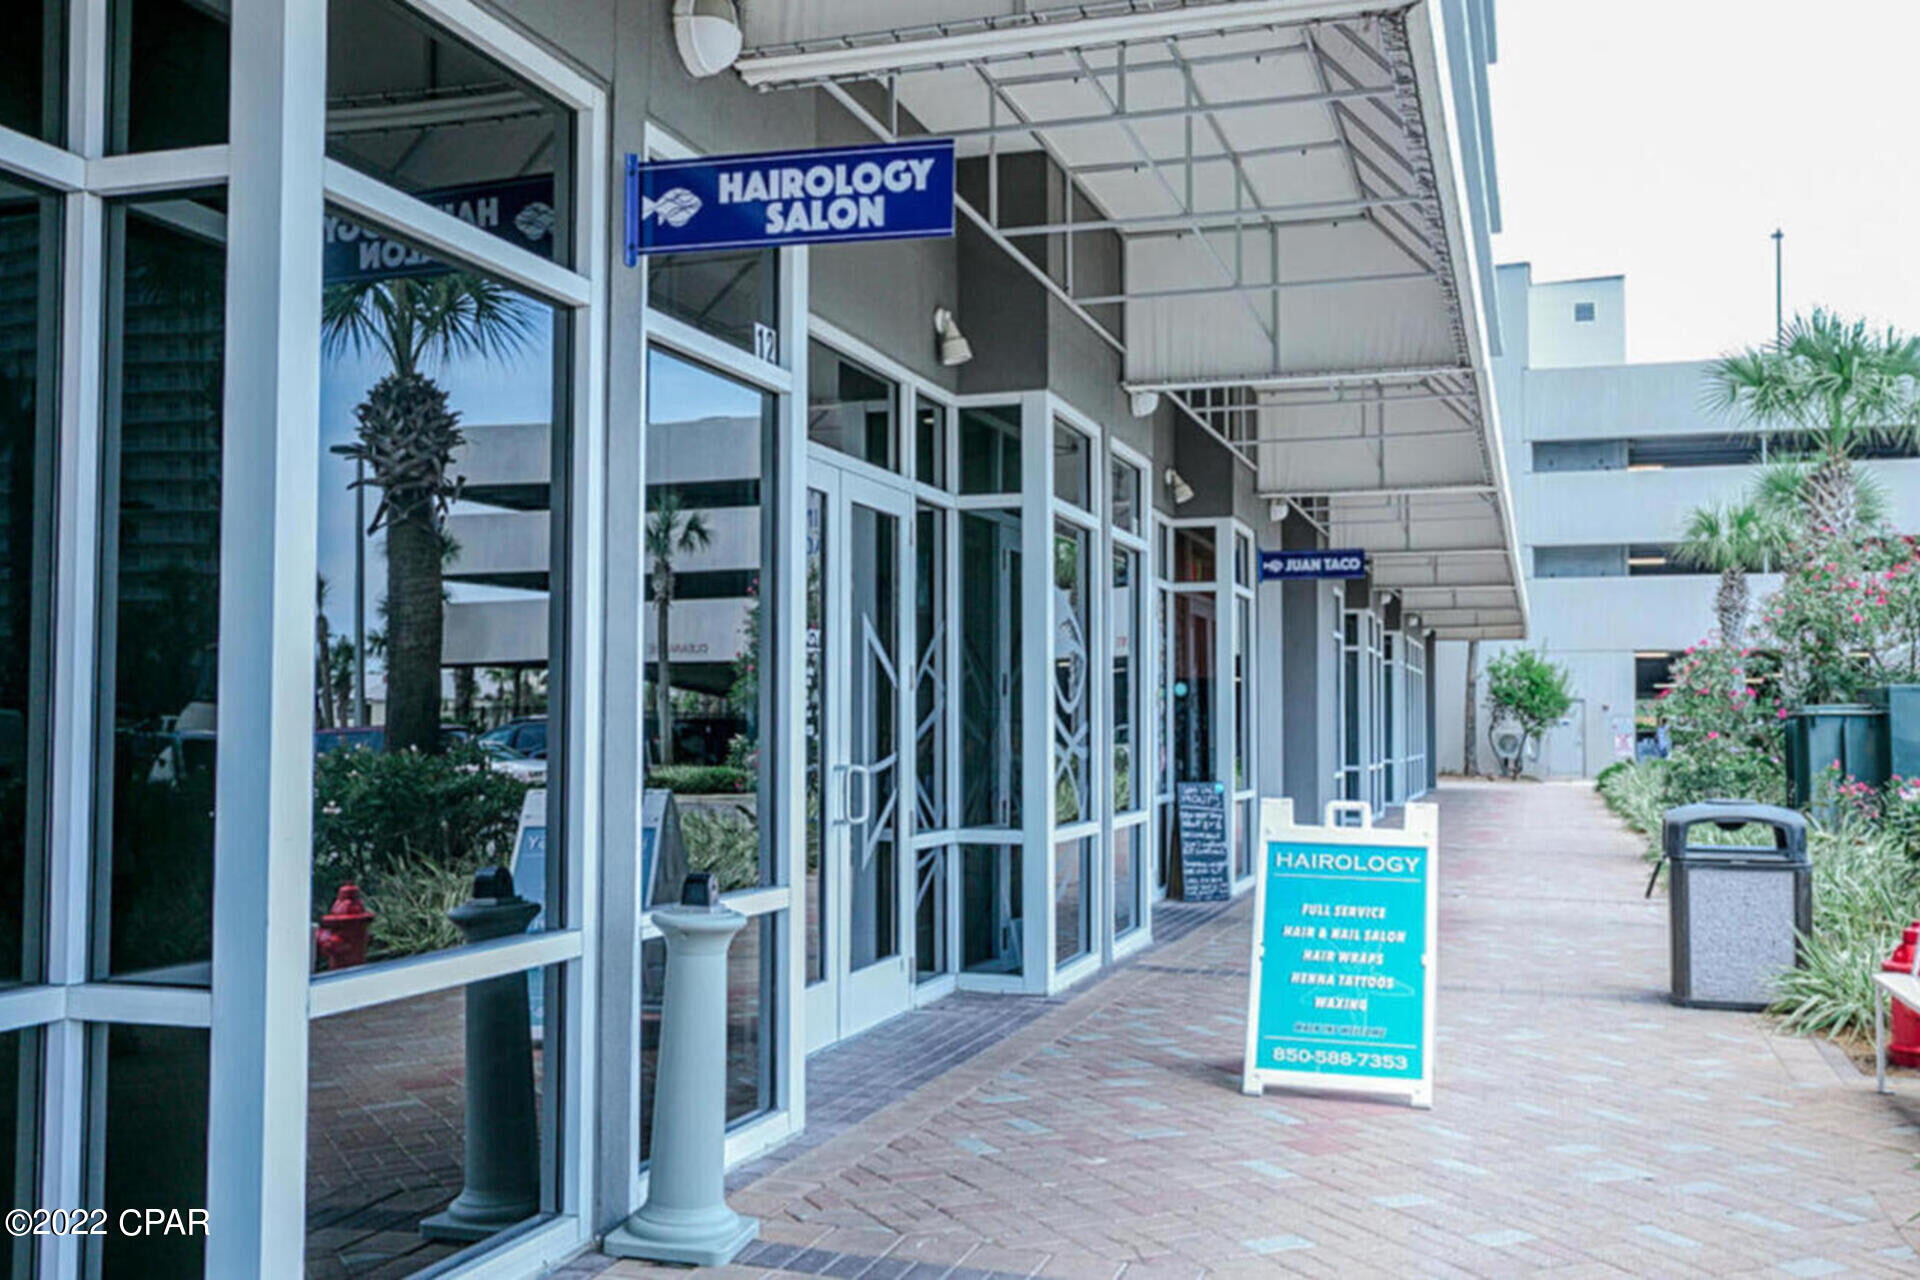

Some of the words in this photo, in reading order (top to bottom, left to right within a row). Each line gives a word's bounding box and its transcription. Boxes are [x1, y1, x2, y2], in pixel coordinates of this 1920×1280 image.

[718, 158, 936, 204] HAIROLOGY
[765, 195, 885, 234] SALON
[1285, 558, 1321, 572] JUAN
[1323, 557, 1362, 571] TACO
[1276, 851, 1421, 873] HAIROLOGY
[1301, 903, 1331, 918] FULL
[1333, 905, 1387, 920] SERVICE
[1283, 925, 1316, 939] HAIR
[1318, 927, 1328, 940] &
[1330, 928, 1361, 942] NAIL
[1364, 930, 1407, 944] SALON
[1302, 949, 1335, 963] HAIR
[1337, 951, 1385, 966] WRAPS
[1290, 972, 1335, 987] HENNA
[1337, 974, 1395, 990] TATTOOS
[1314, 996, 1368, 1012] WAXING
[1273, 1046, 1407, 1070] 850-588-7353
